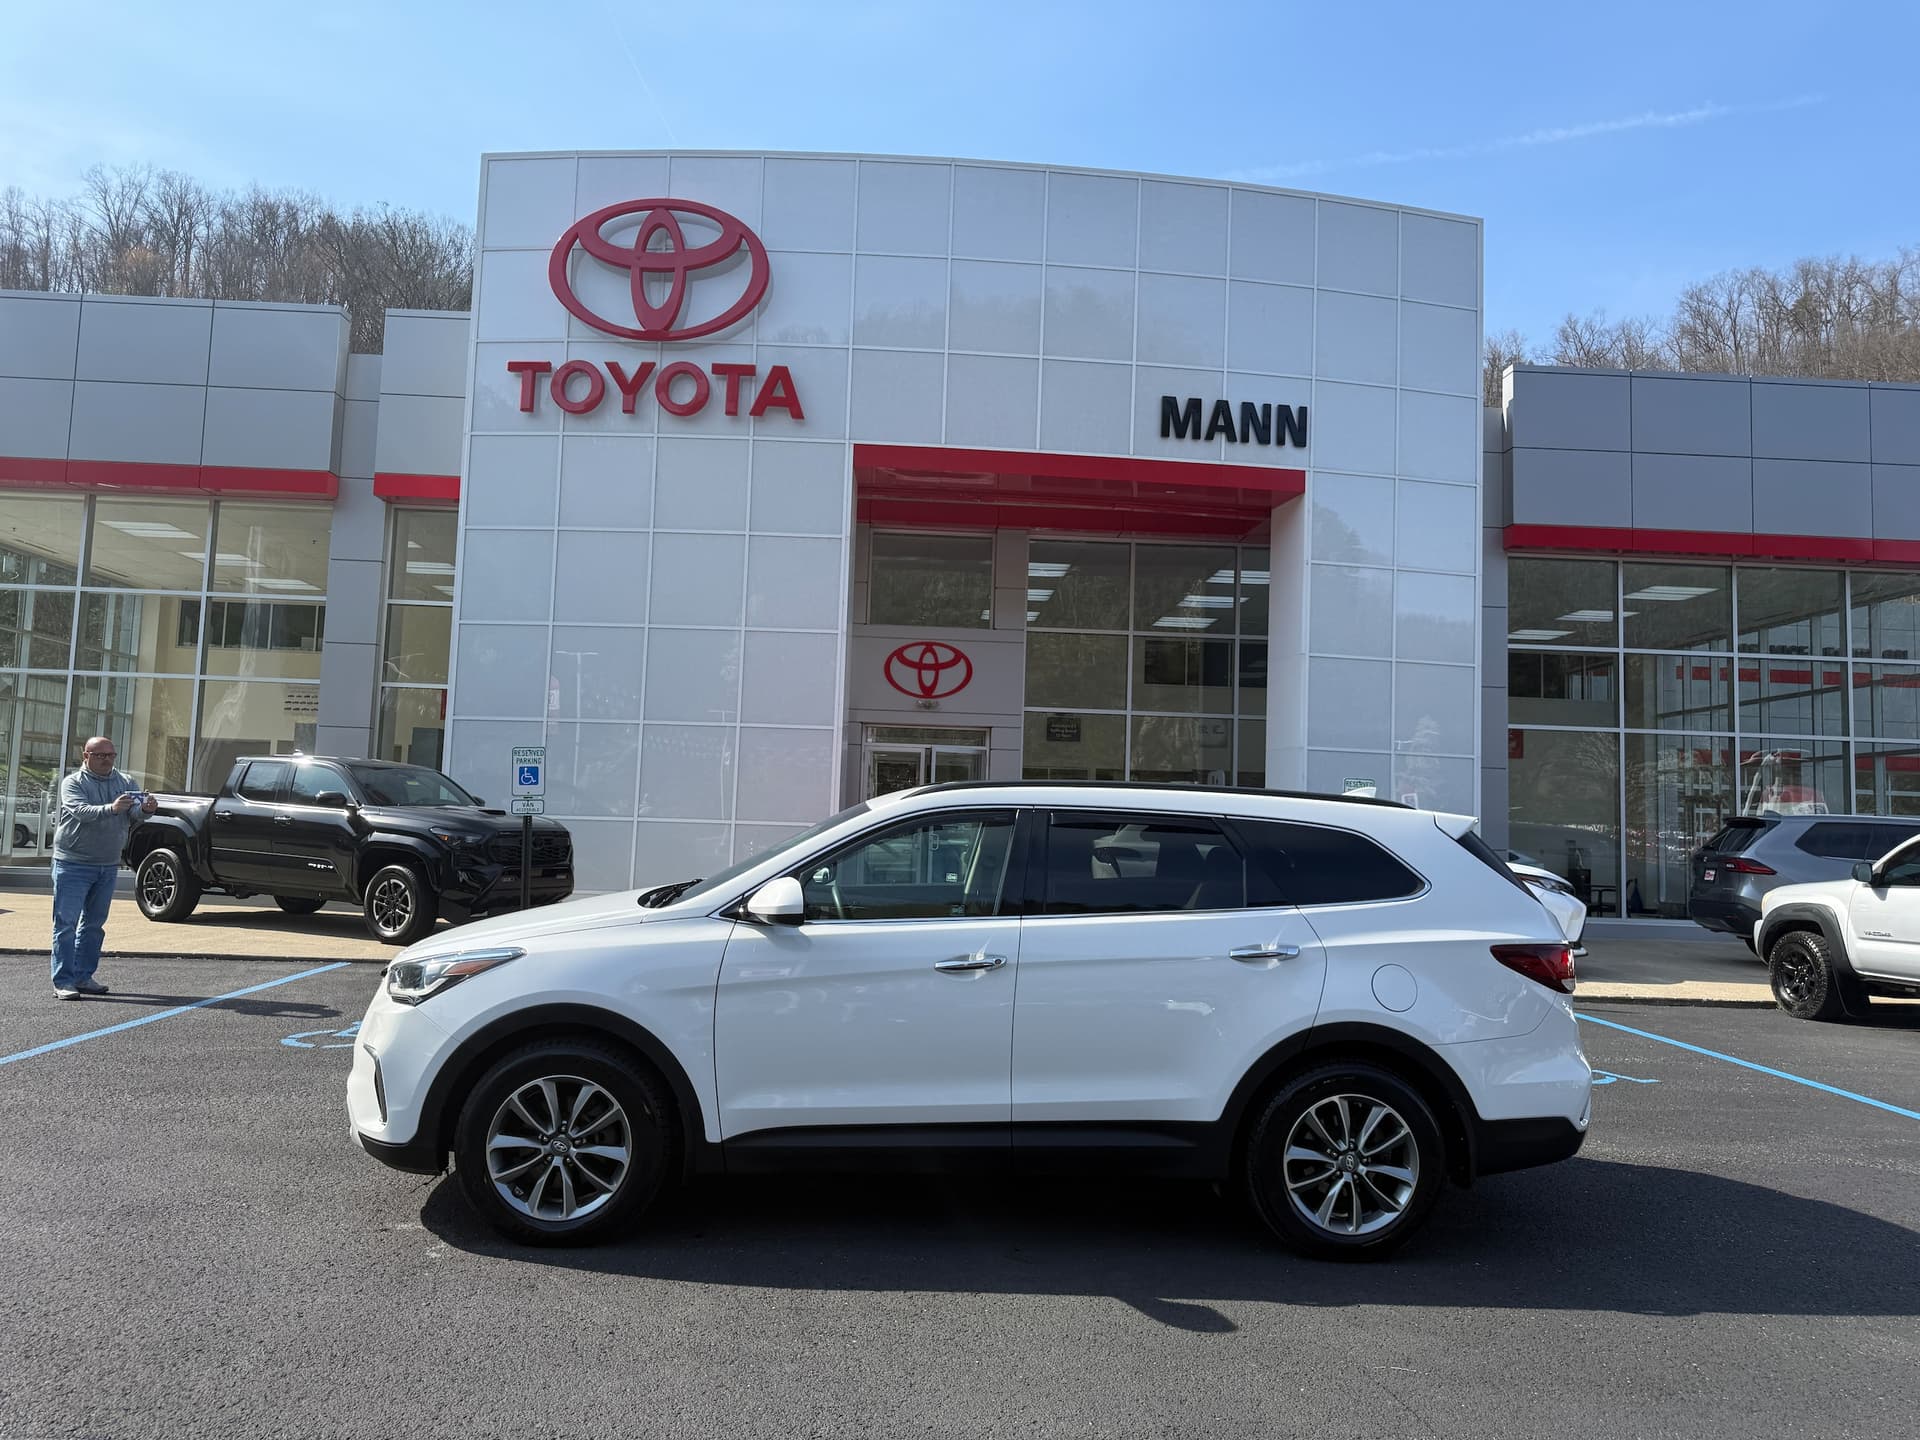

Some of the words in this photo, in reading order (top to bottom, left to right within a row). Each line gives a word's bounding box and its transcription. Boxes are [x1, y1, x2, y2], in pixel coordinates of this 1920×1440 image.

[506, 359, 805, 420] TOYOTA
[1160, 395, 1308, 448] MANN
[513, 749, 545, 757] RESERVED
[516, 757, 542, 765] PARKING
